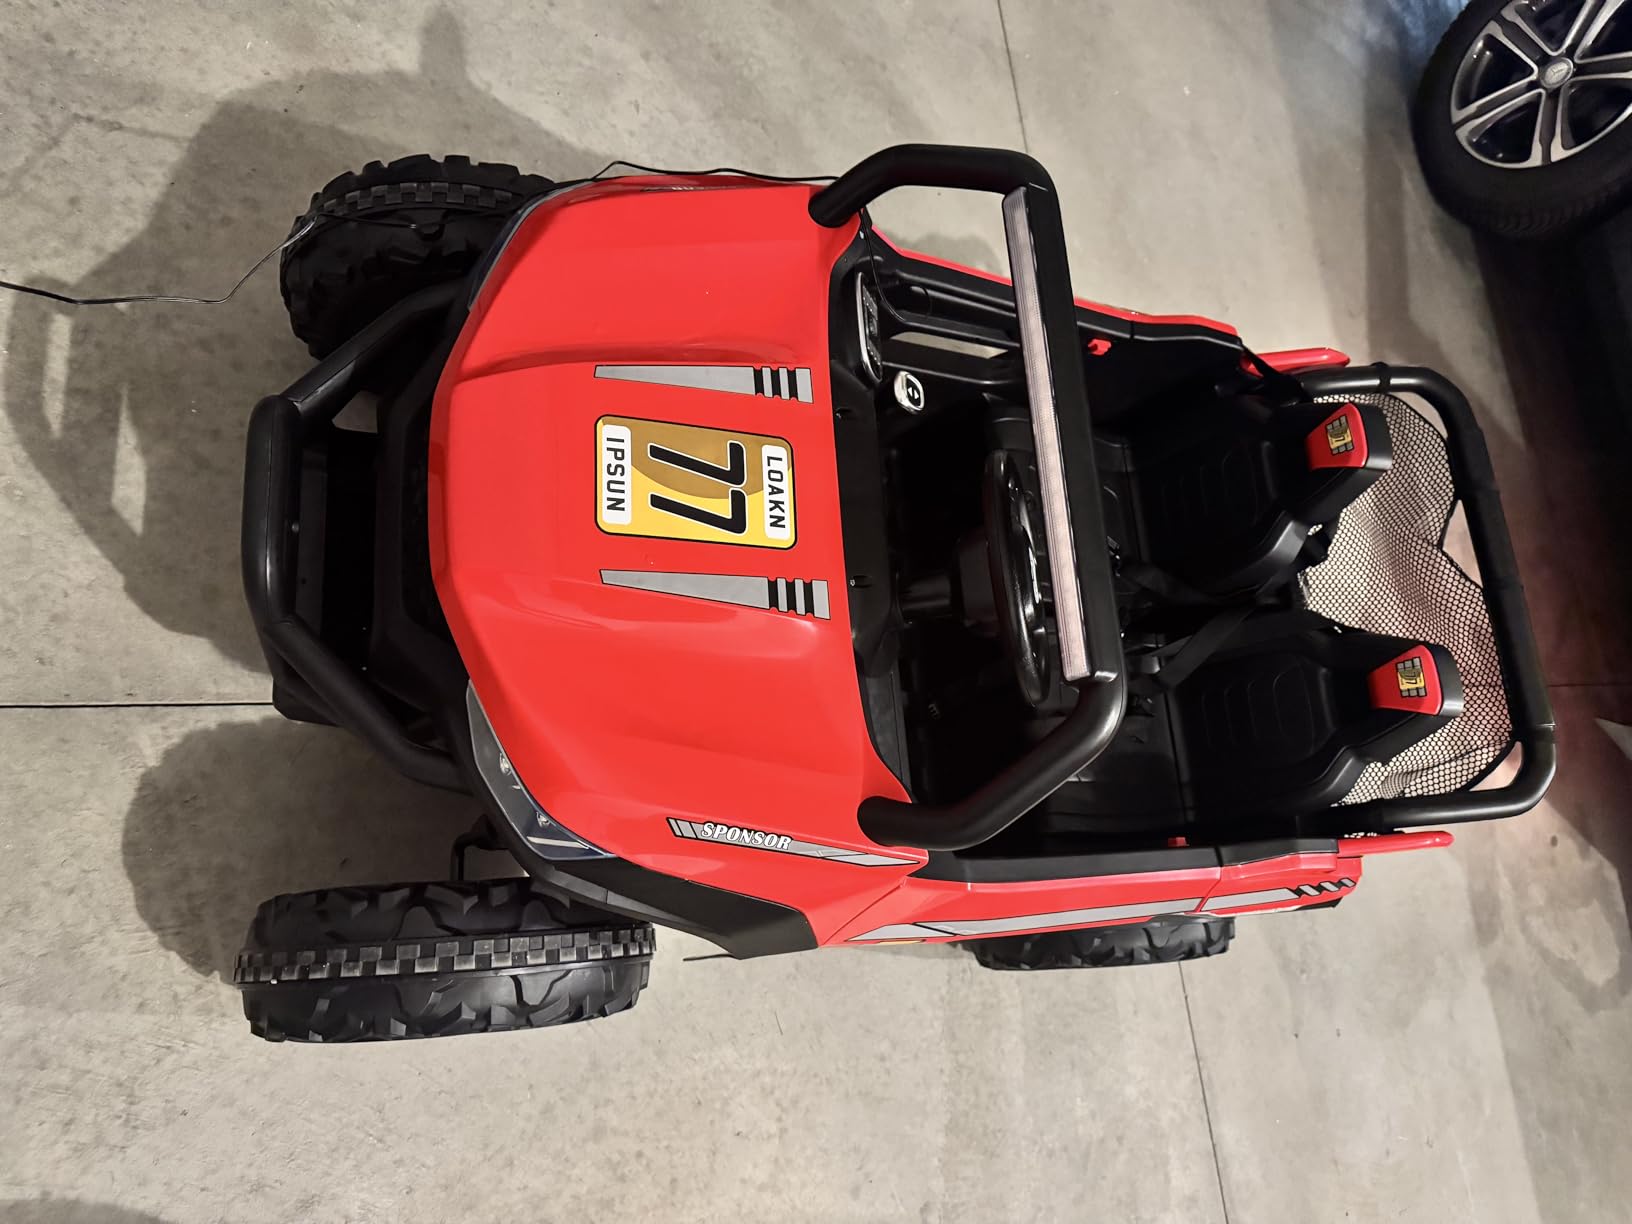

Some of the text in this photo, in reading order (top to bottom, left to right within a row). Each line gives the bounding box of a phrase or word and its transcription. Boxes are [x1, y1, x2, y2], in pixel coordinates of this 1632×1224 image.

[606, 437, 626, 512] IPSUN
[648, 440, 747, 535] 77
[766, 455, 786, 529] LOAKN
[700, 822, 792, 850] SPONSOR
